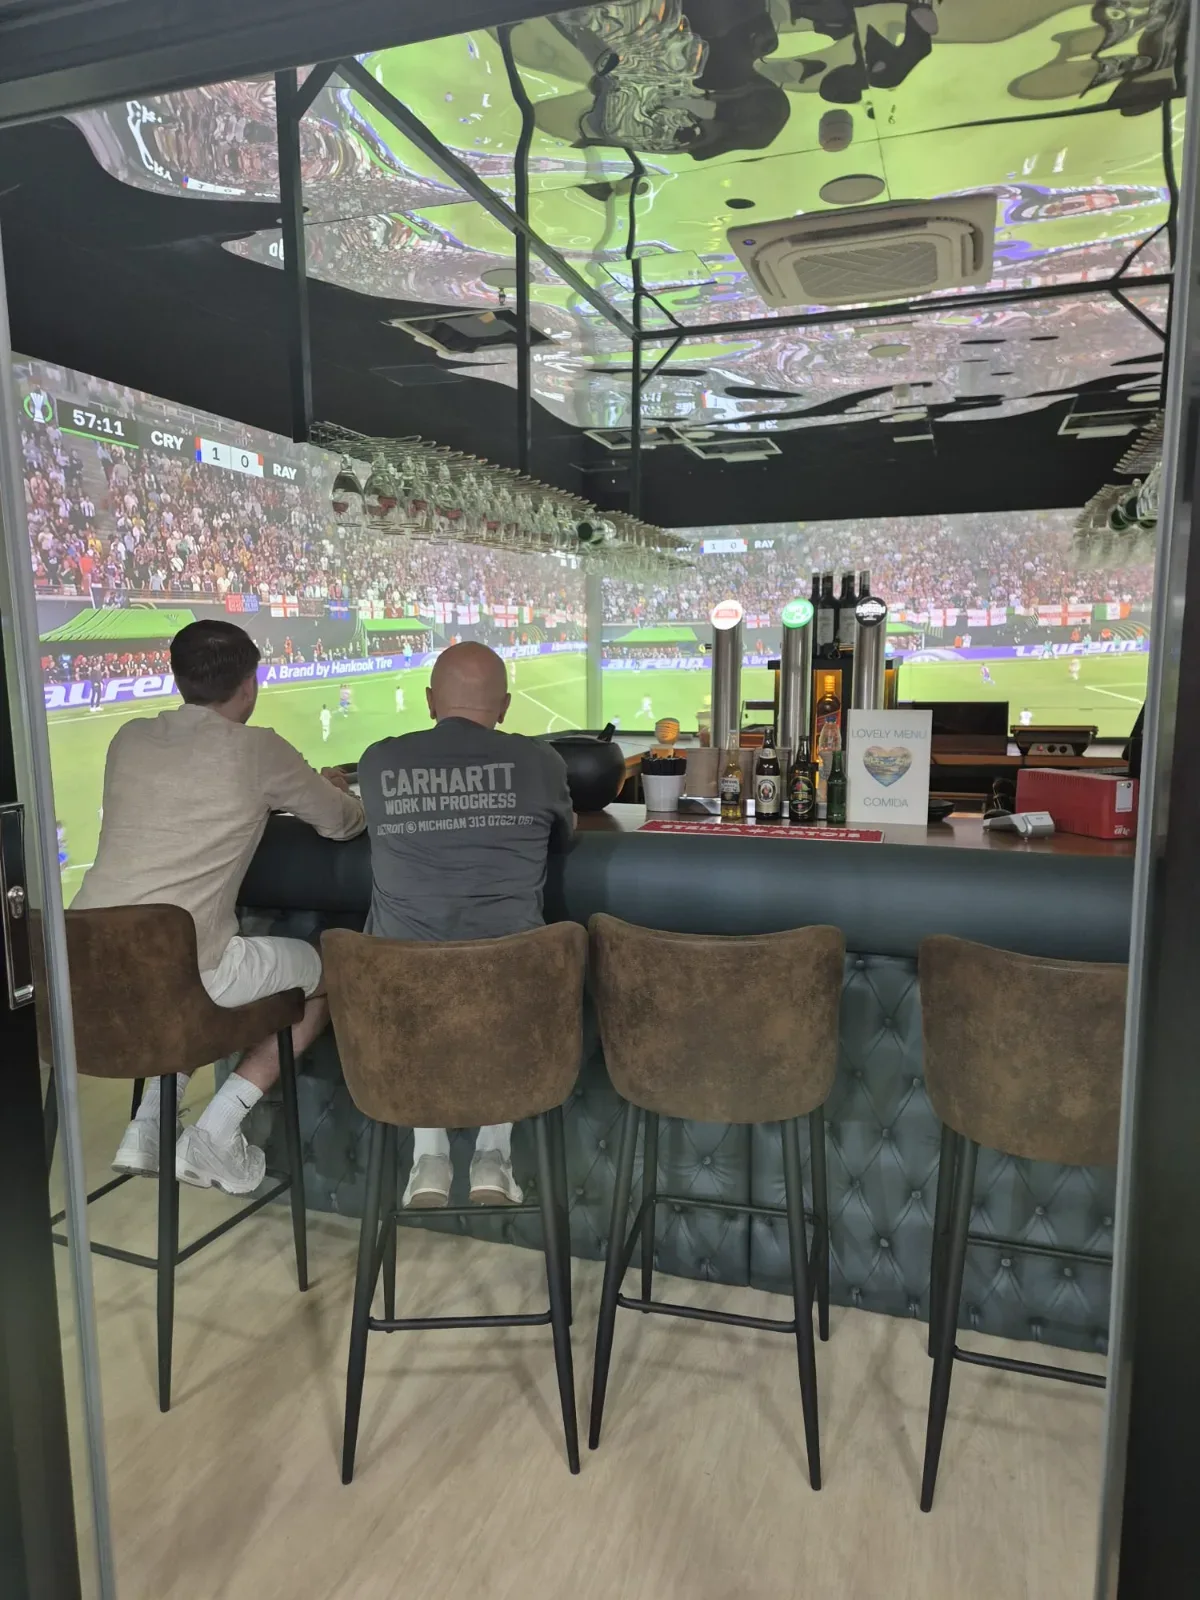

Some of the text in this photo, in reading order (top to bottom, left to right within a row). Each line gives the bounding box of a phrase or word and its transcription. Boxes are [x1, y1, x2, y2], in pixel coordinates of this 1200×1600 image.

[72, 408, 125, 438] 57:11
[150, 429, 297, 481] CRY 1 0 RAY
[754, 540, 775, 549] RAY
[266, 656, 393, 680] A Brand by Hankook Tire
[851, 728, 928, 740] LOVELY MENU
[381, 763, 516, 797] CARHARTT
[384, 793, 516, 815] WORK IN PROGRESS
[863, 797, 909, 808] COMIDA
[418, 818, 467, 832] MICHIGAN
[468, 815, 486, 828] 313
[660, 823, 862, 839] STELLA ARTOIS
